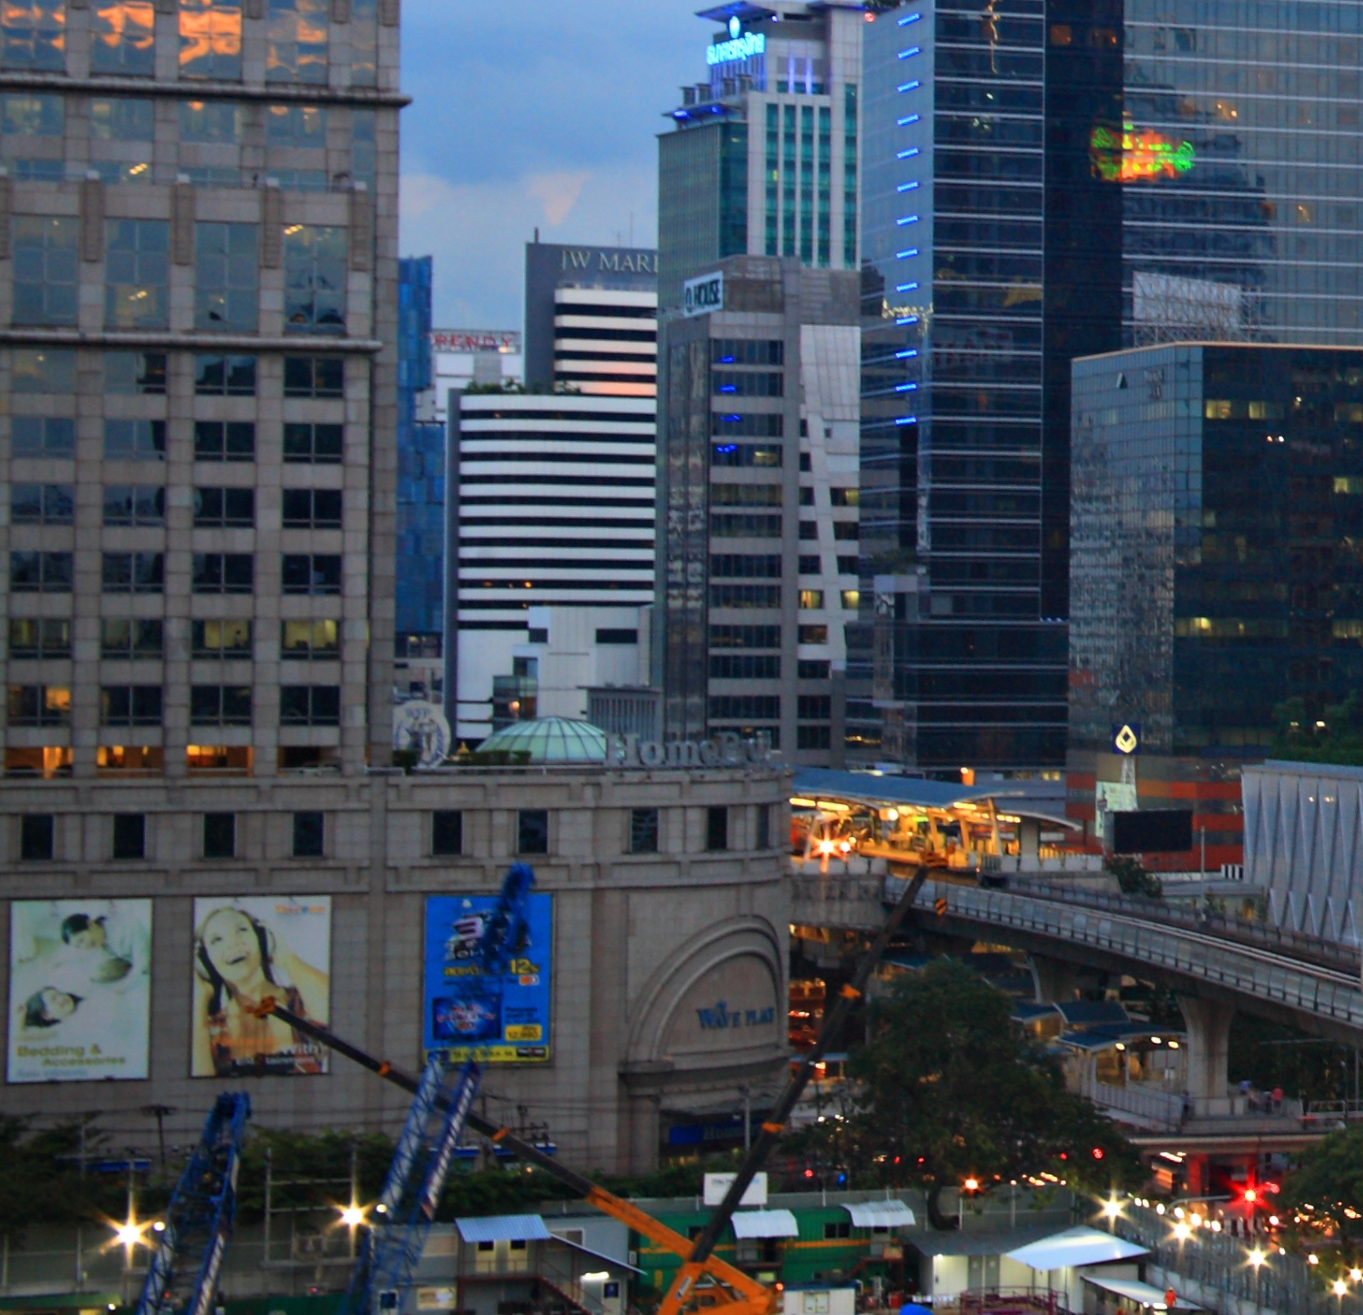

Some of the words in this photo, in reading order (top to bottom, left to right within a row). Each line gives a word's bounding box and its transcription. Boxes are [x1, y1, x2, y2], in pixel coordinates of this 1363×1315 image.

[560, 250, 591, 271] JW
[694, 278, 720, 306] HOUSE
[430, 333, 513, 349] RENDY
[695, 1001, 740, 1029] WAVE
